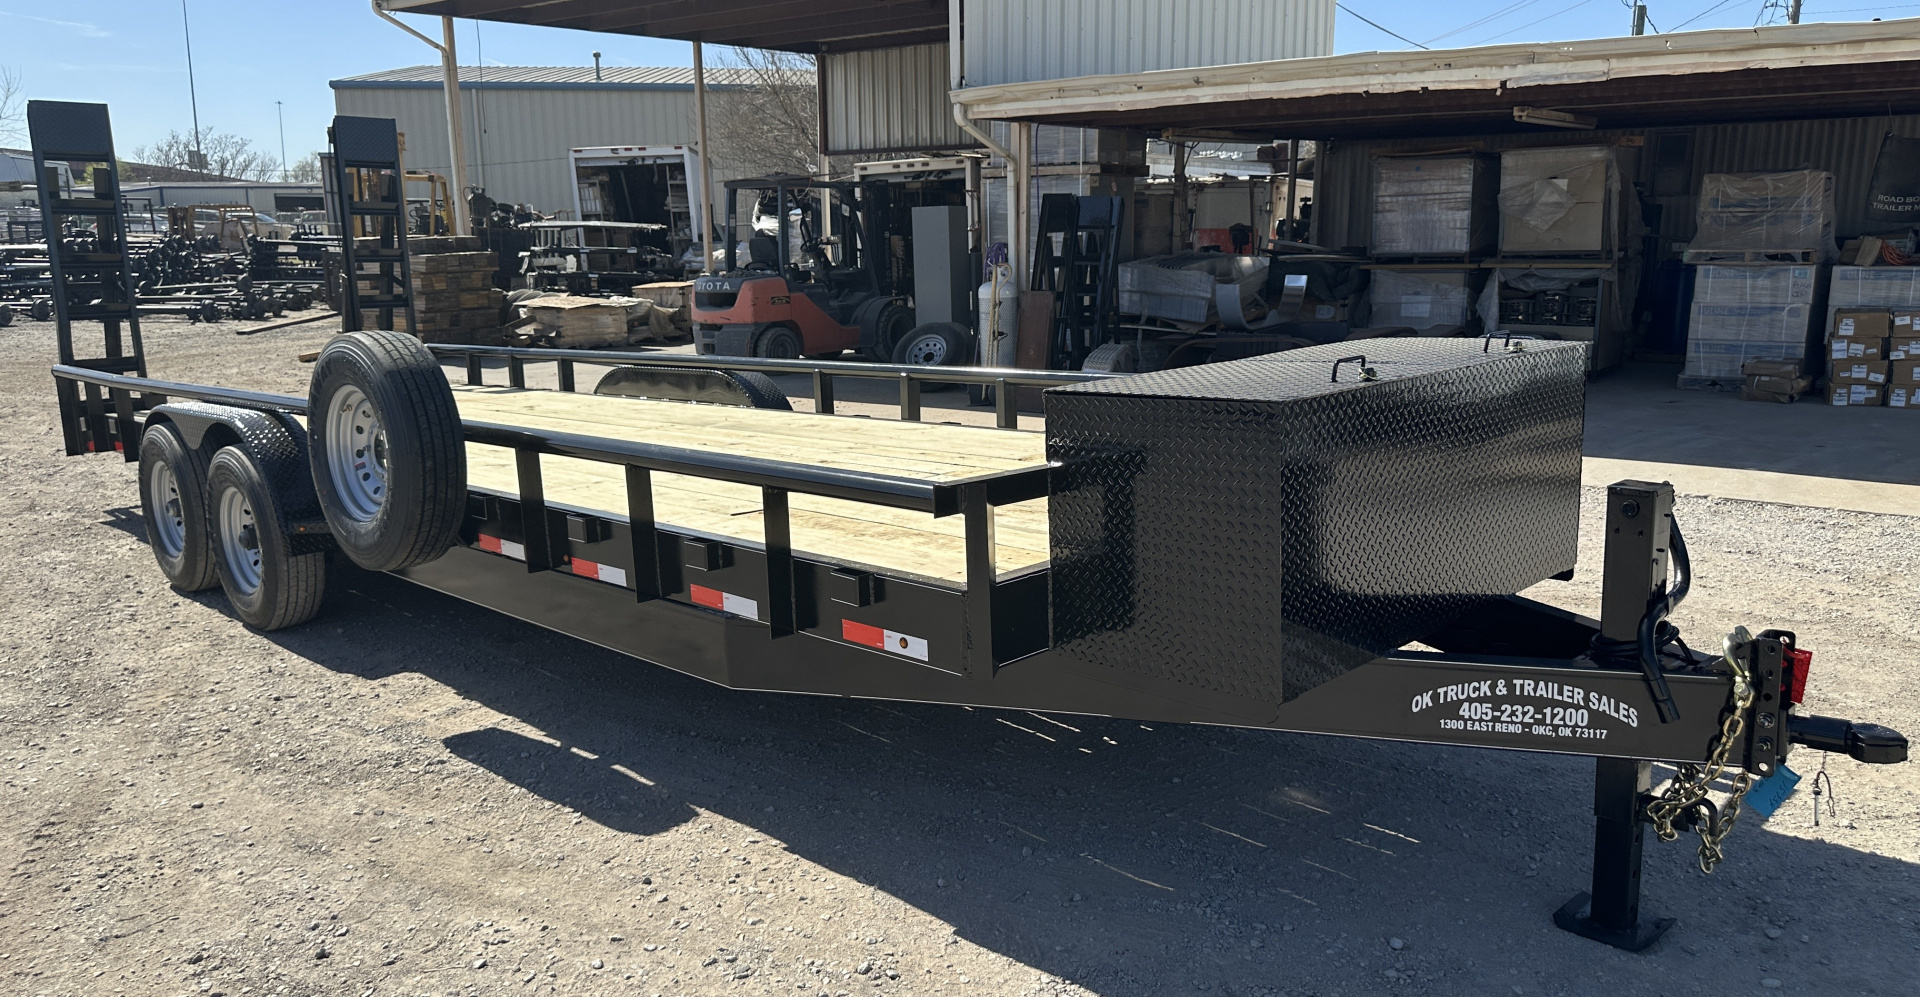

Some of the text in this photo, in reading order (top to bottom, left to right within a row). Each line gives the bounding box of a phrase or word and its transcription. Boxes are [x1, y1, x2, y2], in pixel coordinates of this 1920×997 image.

[1877, 194, 1904, 203] ROAD
[1872, 202, 1912, 212] TRAILER
[1846, 270, 1875, 279] ULNE
[1704, 306, 1729, 315] ULINE
[1411, 679, 1638, 728] OK TRUCK & TRAILER SALES
[1458, 701, 1589, 727] 405-232-1200
[1439, 718, 1465, 730] 1300
[1466, 720, 1494, 732] EAST
[1495, 722, 1522, 734] RENO
[1531, 724, 1556, 738] OKC,
[1558, 726, 1573, 737] OK
[1575, 728, 1608, 740] 73117
